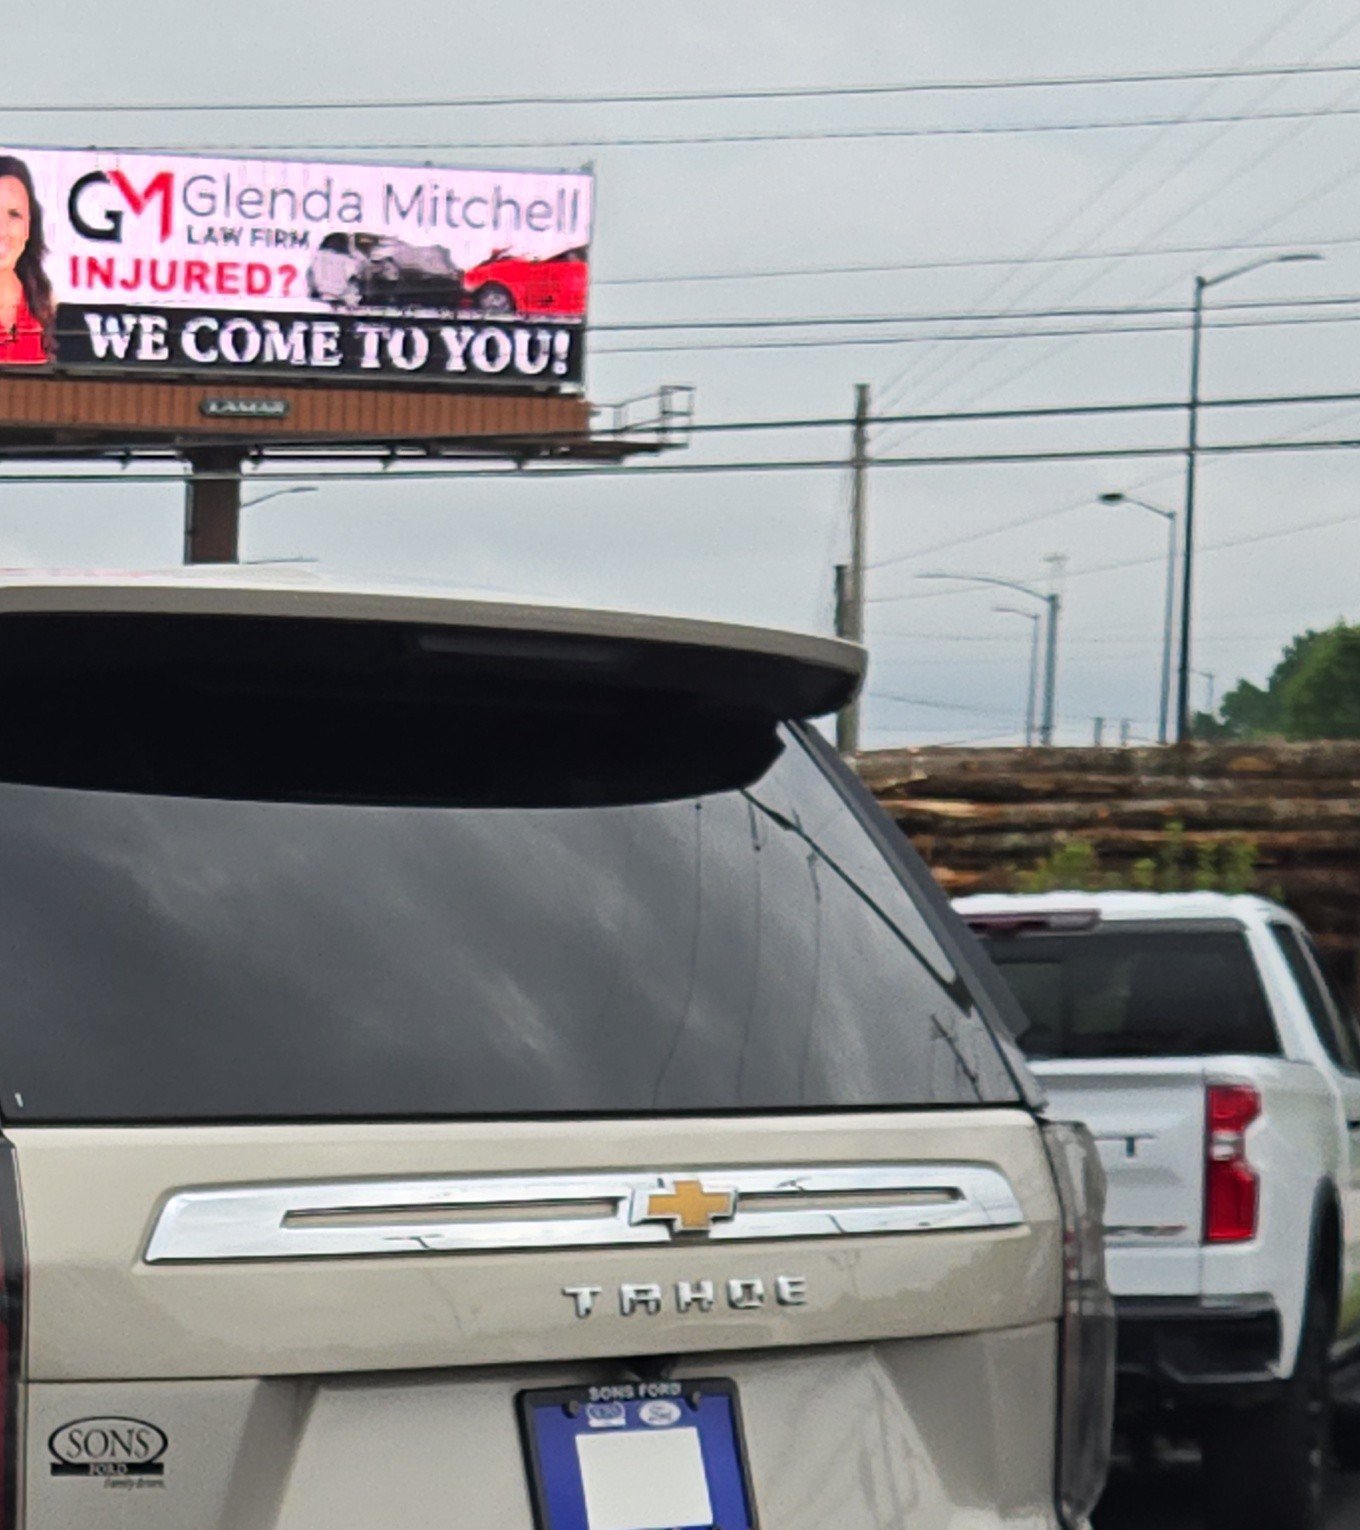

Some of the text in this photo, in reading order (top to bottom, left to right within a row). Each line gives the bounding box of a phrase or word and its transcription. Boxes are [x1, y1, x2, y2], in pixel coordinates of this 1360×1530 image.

[68, 169, 174, 243] GM
[182, 174, 579, 233] Glenda Mitchell
[187, 224, 311, 249] LAW FIRM
[70, 255, 299, 297] INJURED?
[83, 312, 571, 375] WE COME TO YOU!
[562, 1274, 809, 1319] TAHOE
[588, 1381, 683, 1401] SONS FORD
[66, 1428, 151, 1459] SONS
